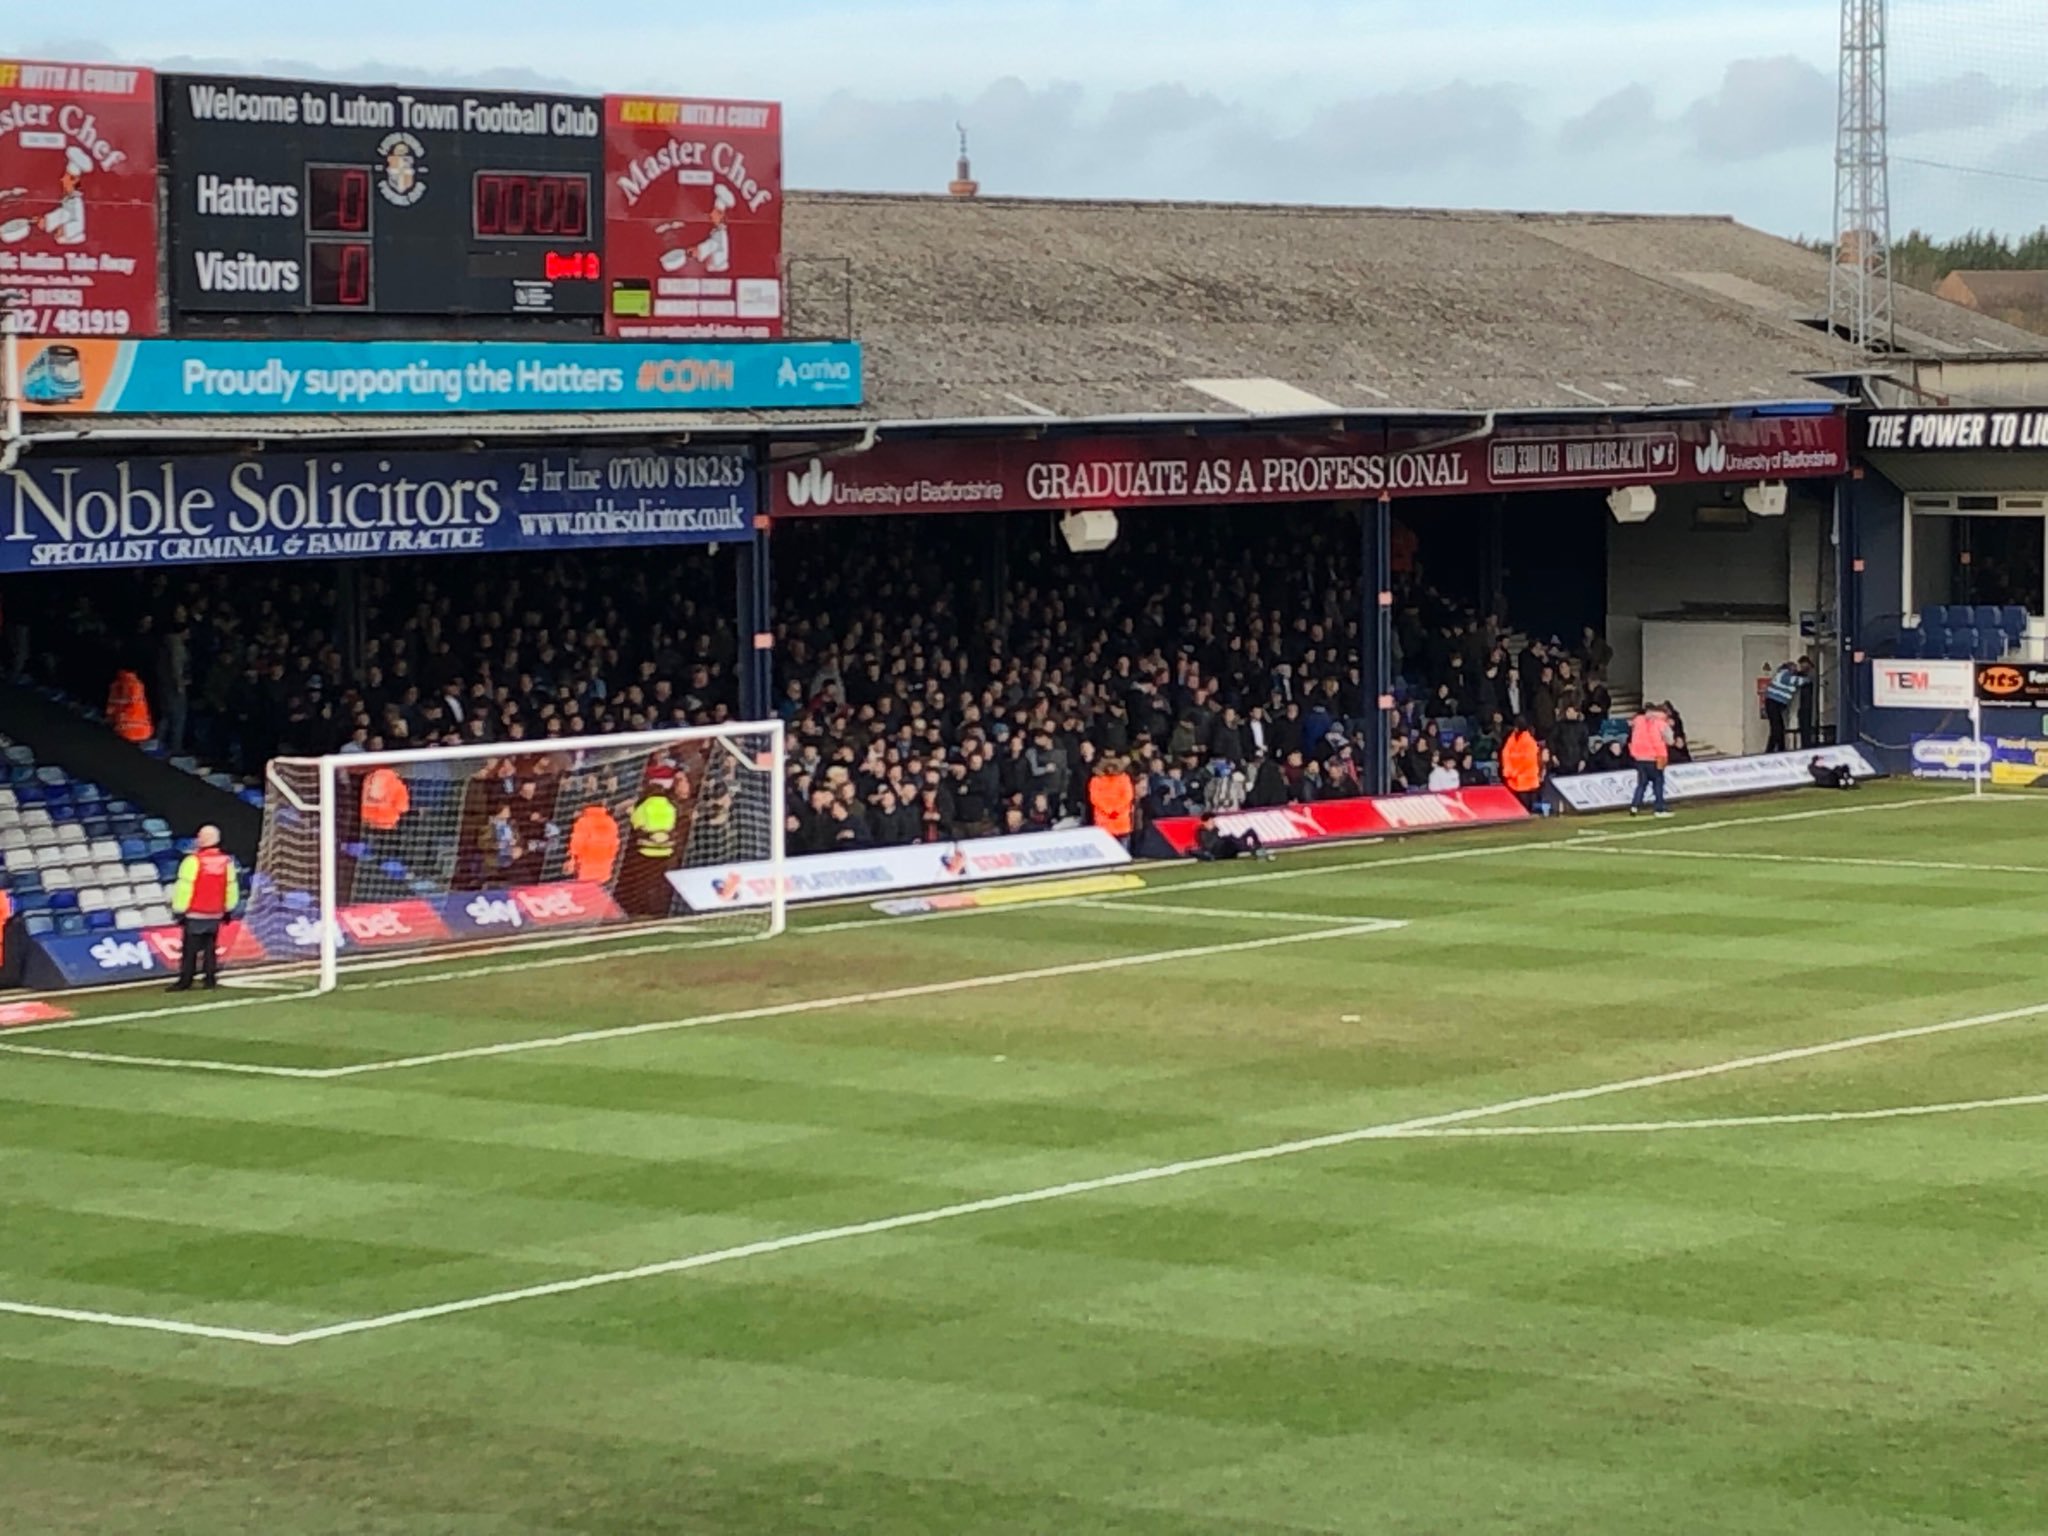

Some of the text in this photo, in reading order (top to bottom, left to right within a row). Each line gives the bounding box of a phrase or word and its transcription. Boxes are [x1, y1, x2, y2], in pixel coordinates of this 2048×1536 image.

[190, 84, 598, 136] Welcome to Luton Town Football Club
[0, 101, 127, 172] ster Chef
[197, 174, 299, 217] Hatters
[616, 139, 773, 213] Master Chef
[195, 252, 299, 292] Visitors
[53, 309, 129, 334] 481919
[182, 358, 623, 403] Proudly supporting the Hatters
[637, 359, 734, 393] #COYH
[1867, 414, 1907, 448] THE
[1908, 413, 1985, 448] POWER
[1990, 413, 2018, 448] TO
[542, 458, 565, 491] hr
[568, 458, 601, 490] line
[608, 456, 669, 490] 07000
[674, 455, 744, 488] 818283
[834, 479, 1004, 506] University of Bedfordshire
[1028, 453, 1468, 500] GRADUATE AS A PROFESSIONAL
[5, 458, 499, 541] Noble Solicitors
[519, 494, 745, 536] www.noblesolicitors.co.uk
[31, 526, 485, 566] SPECIALIST CRIMINAL & FAMILY PRACTICE
[1885, 671, 1928, 690] TEM
[1982, 671, 2020, 688] hts
[341, 907, 412, 938] bet
[466, 889, 585, 927] sky bet
[90, 936, 153, 970] sky
